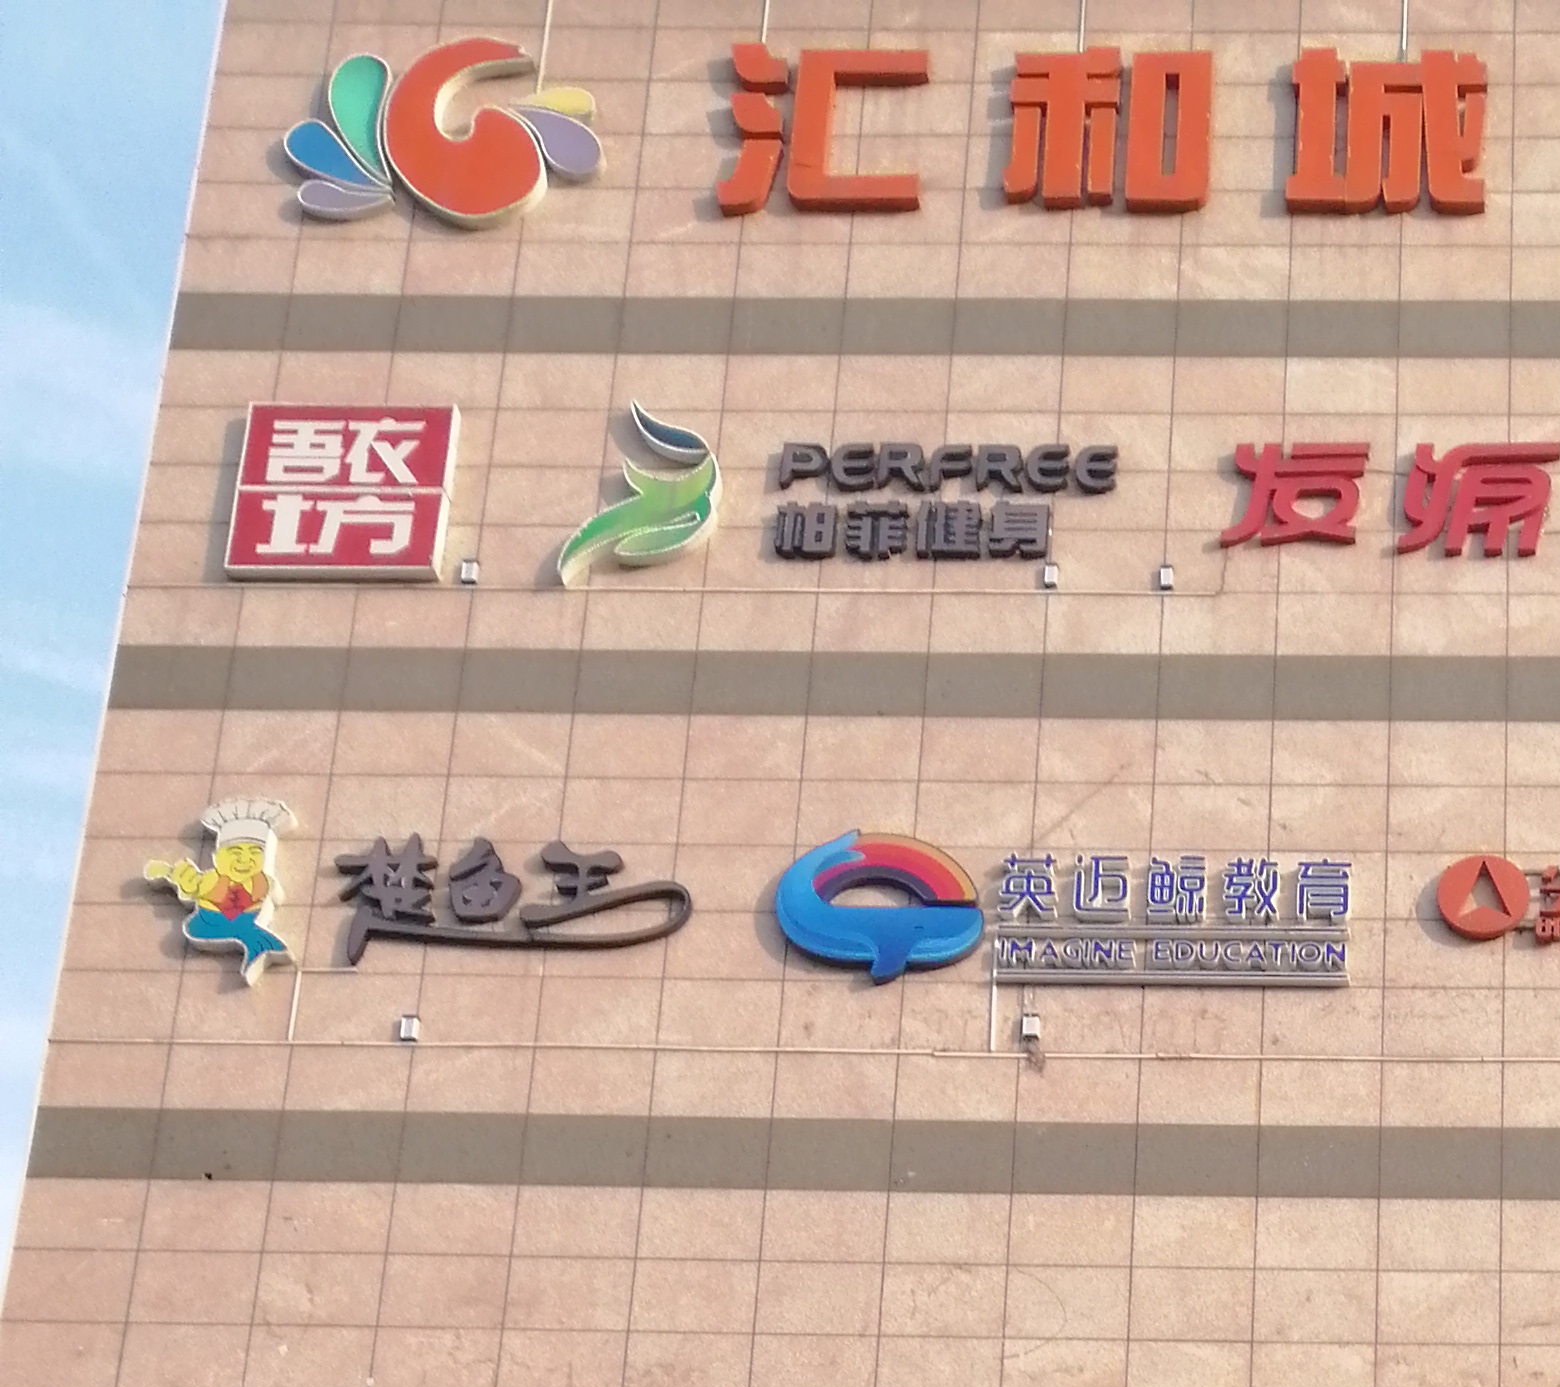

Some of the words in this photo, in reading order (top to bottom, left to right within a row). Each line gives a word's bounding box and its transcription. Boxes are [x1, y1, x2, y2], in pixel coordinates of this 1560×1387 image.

[717, 42, 1487, 217] 汇和城
[776, 442, 1118, 495] PERFREE
[256, 496, 415, 557] 坊
[334, 831, 693, 967] 楚鱼王
[998, 853, 1351, 923] 英迈鲸教育
[999, 938, 1136, 969] IMAGINE
[1152, 940, 1348, 970] EDUCATION
